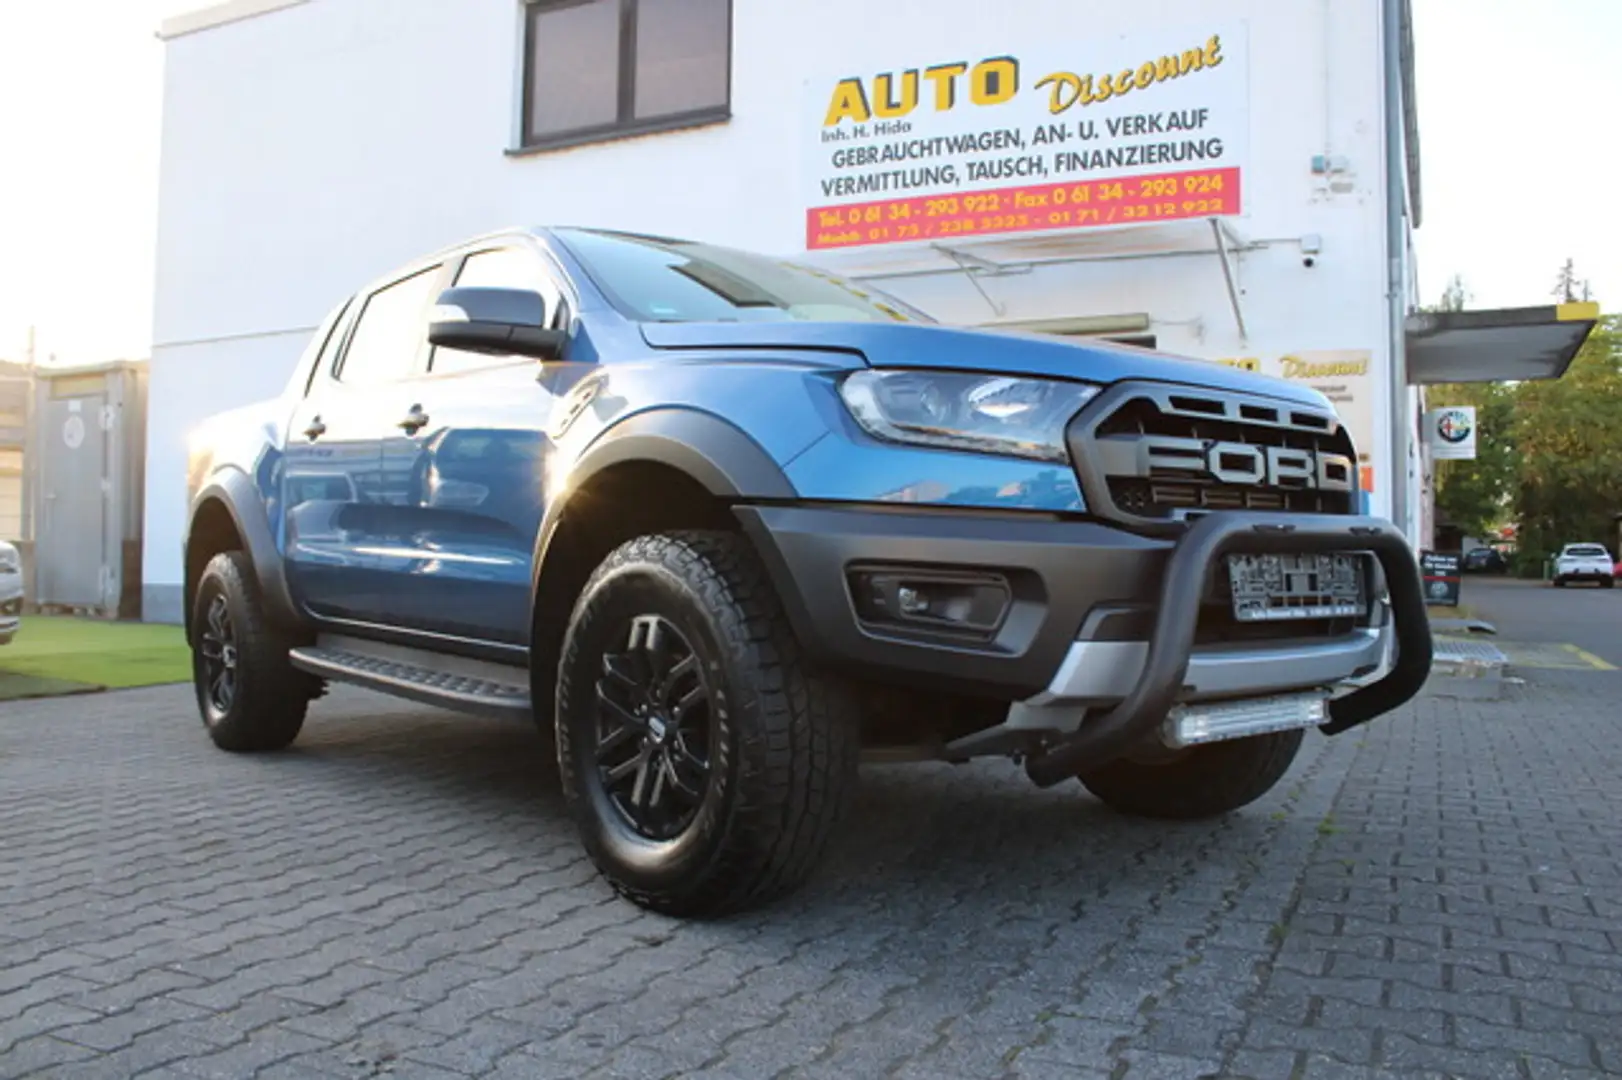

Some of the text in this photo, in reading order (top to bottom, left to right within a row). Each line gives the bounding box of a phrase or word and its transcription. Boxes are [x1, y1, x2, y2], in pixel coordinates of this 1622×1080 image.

[823, 34, 1224, 126] AUTO Discount
[821, 138, 1224, 197] VERMITTLUNG, TAUSCH, FINANZIERUNG
[832, 108, 1209, 169] GEBRAUCHTWAGEN, AN- U. VERKAUF
[1014, 192, 1048, 209] Fax
[1140, 178, 1177, 198] 293
[1183, 174, 1224, 193] 924
